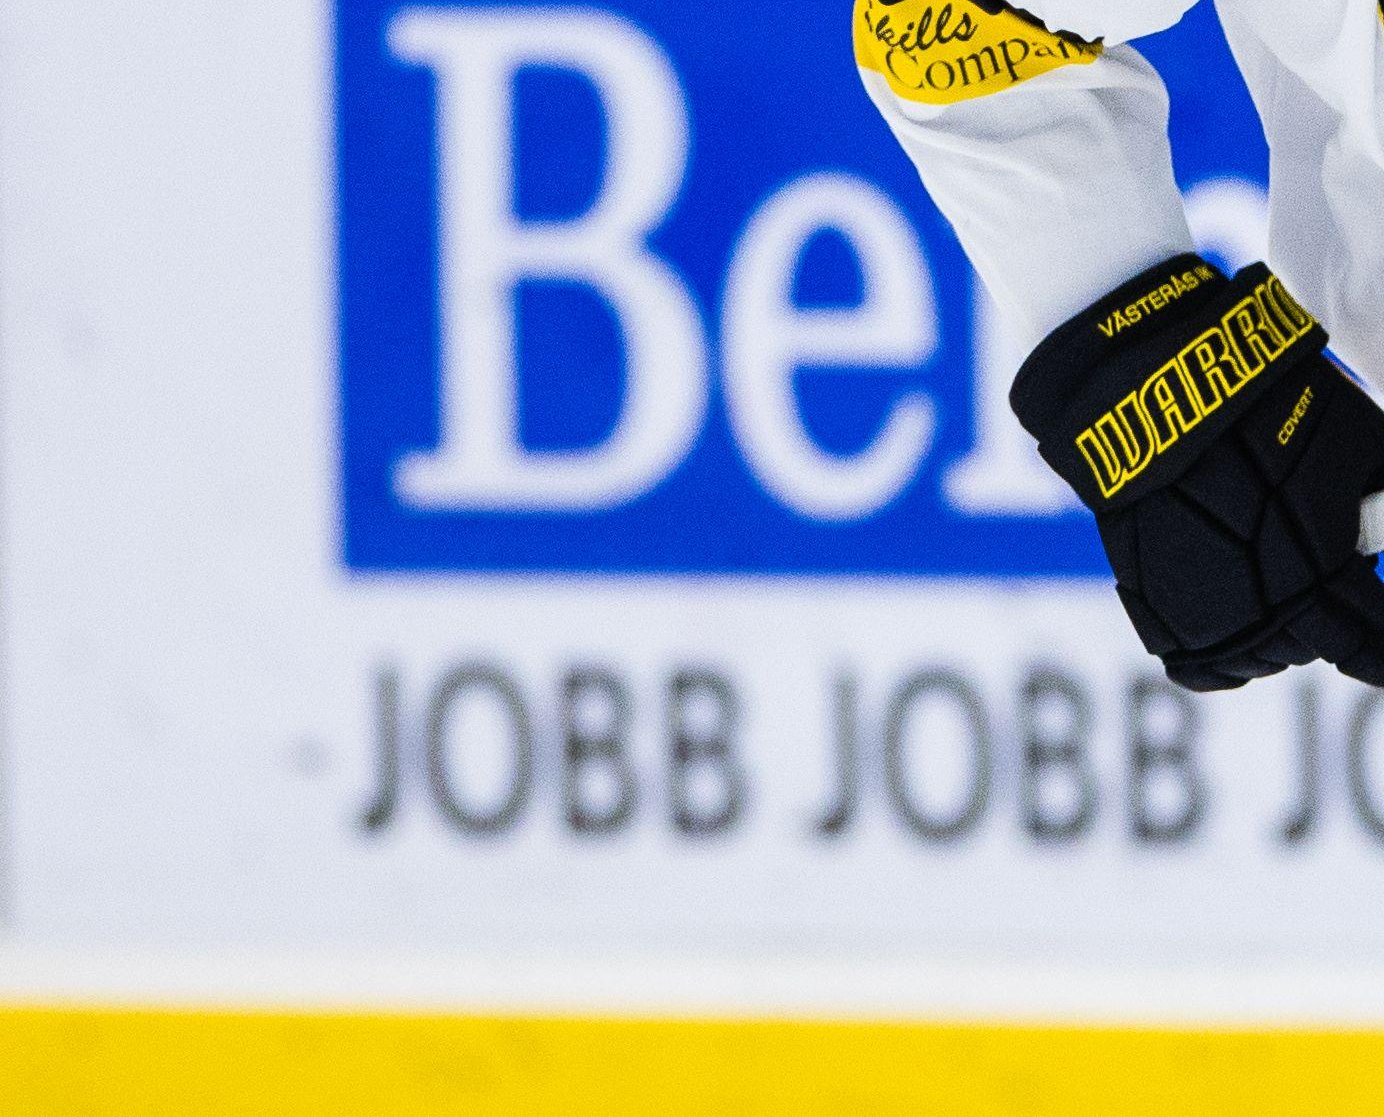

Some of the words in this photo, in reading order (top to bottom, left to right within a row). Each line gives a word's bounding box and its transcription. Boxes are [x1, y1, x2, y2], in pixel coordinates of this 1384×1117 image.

[1097, 271, 1199, 337] VÄSTERÅS
[1075, 275, 1320, 498] WARRIO
[1278, 386, 1313, 445] COVERT
[358, 664, 748, 842] JOBB
[813, 662, 1216, 848] JOBB
